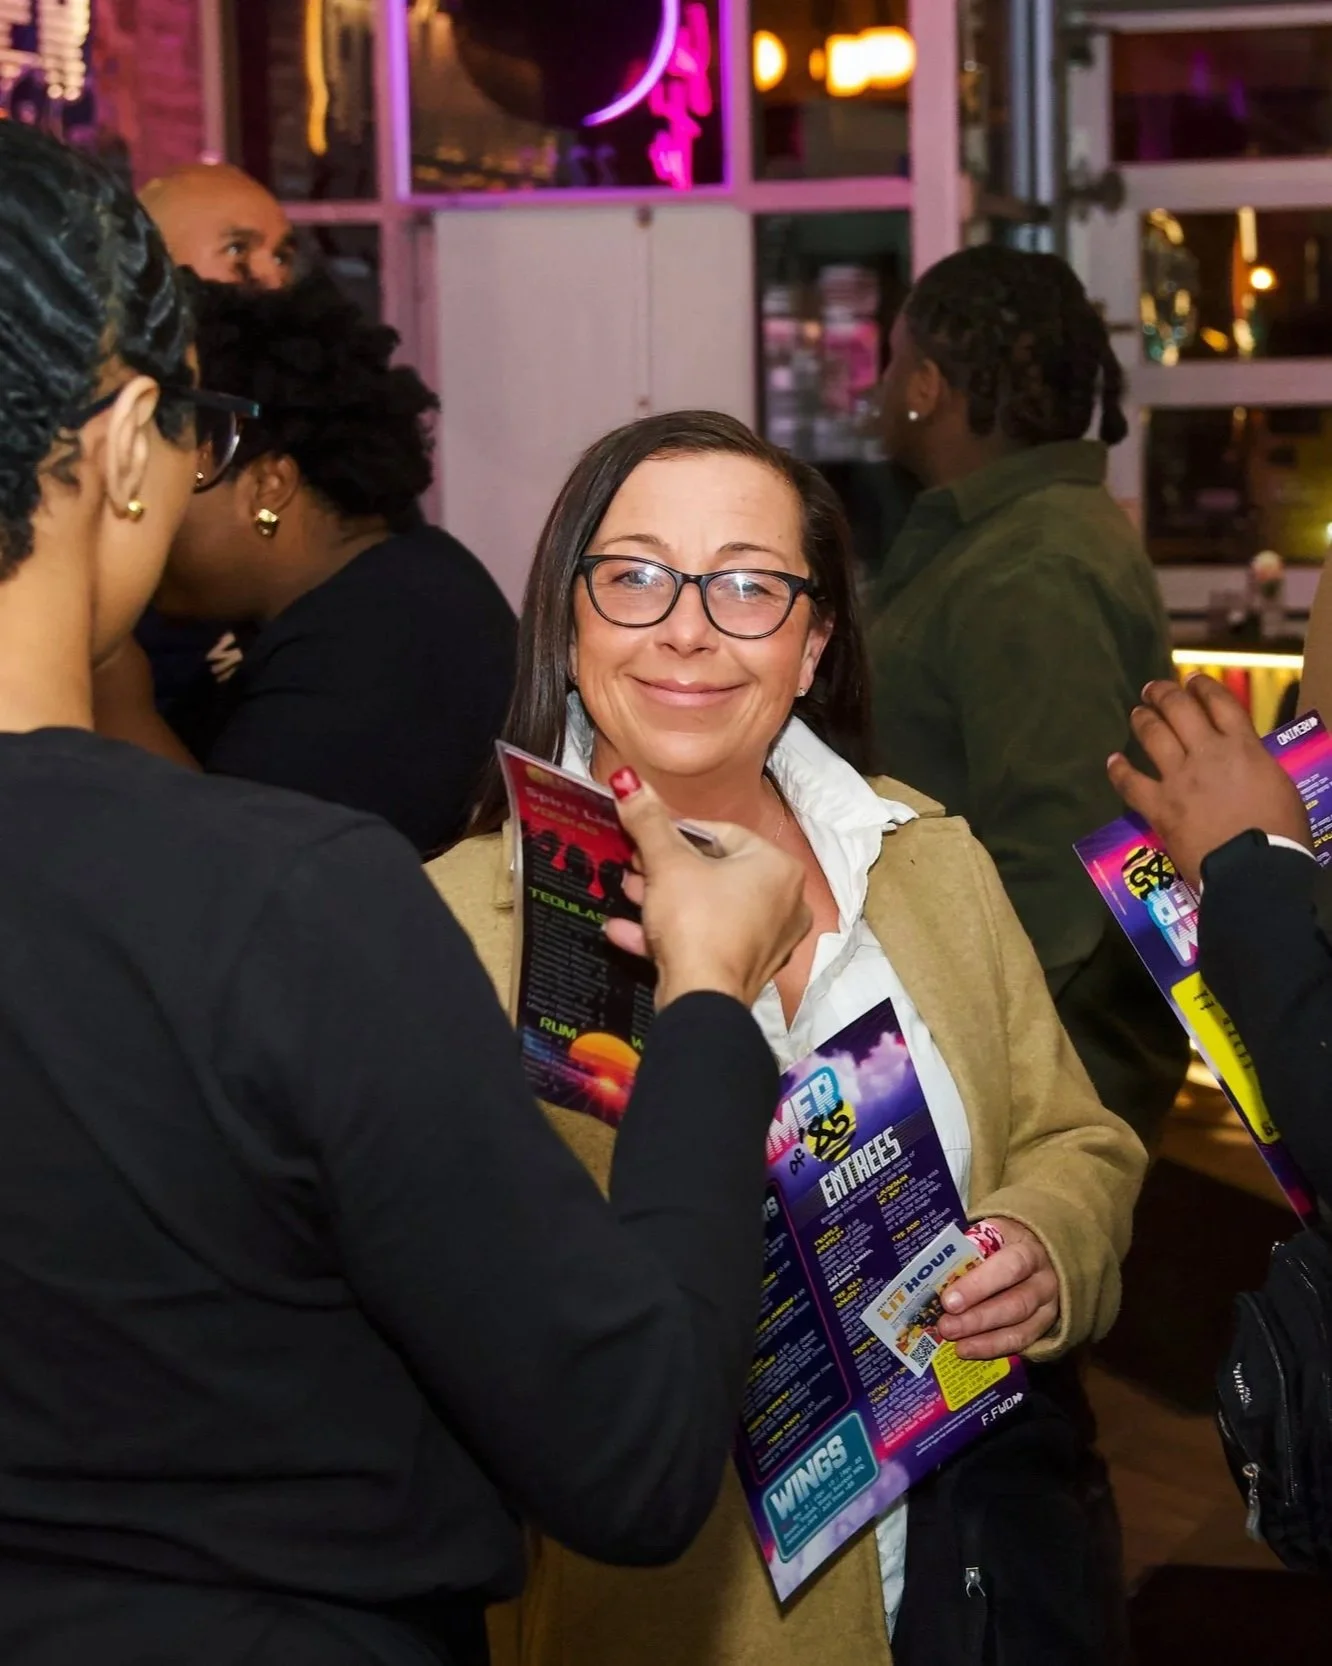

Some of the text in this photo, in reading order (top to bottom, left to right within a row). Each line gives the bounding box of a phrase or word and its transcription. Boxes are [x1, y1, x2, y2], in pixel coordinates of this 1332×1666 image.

[1277, 719, 1312, 746] REWIND
[540, 1016, 577, 1040] RUM
[766, 1072, 839, 1162] MER
[818, 1126, 902, 1208] ENTREES
[879, 1289, 906, 1321] LIT
[904, 1243, 957, 1293] HOUR
[980, 1397, 1015, 1427] F.FWD
[769, 1434, 848, 1520] WINGS
